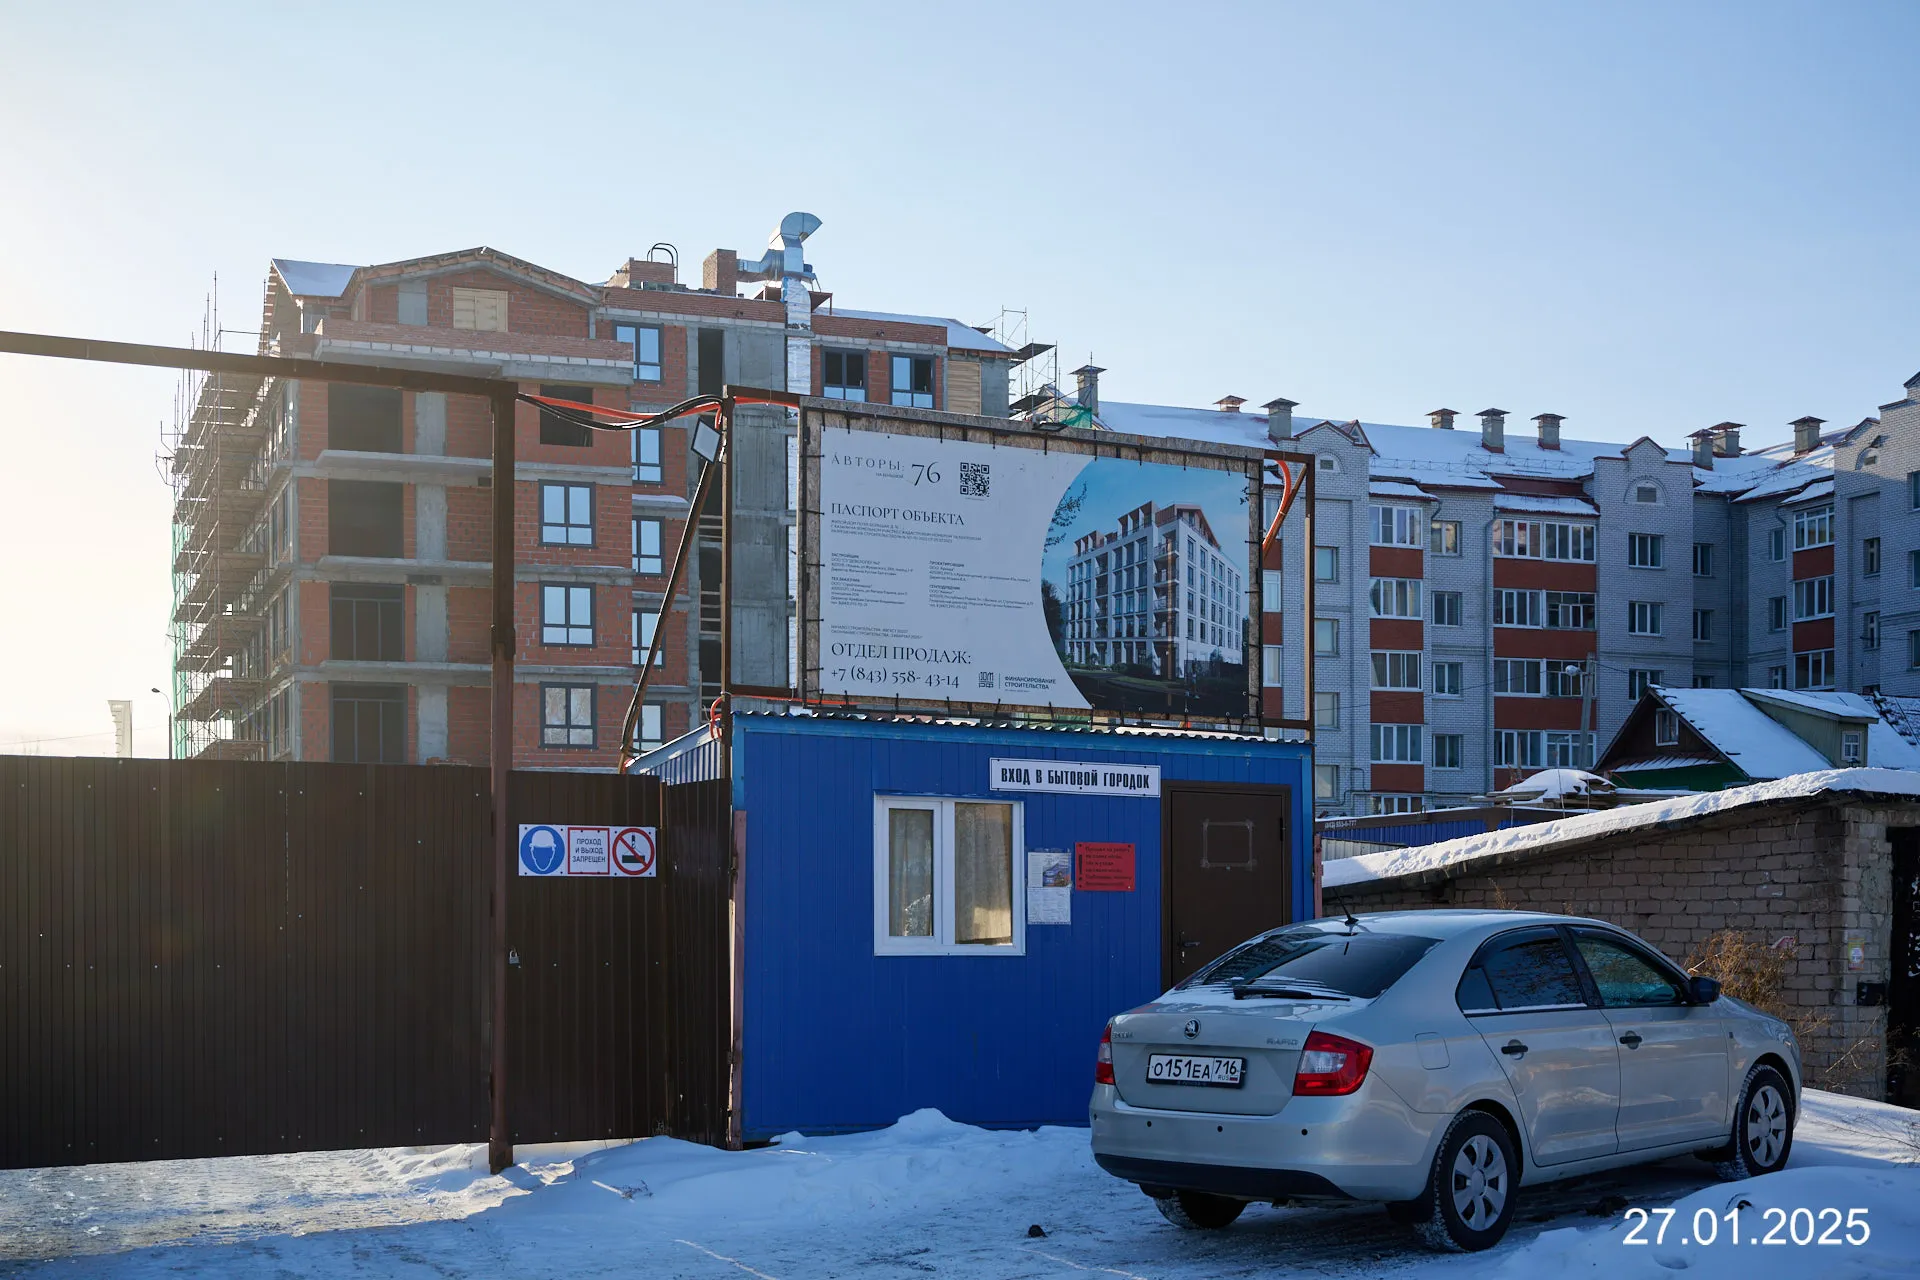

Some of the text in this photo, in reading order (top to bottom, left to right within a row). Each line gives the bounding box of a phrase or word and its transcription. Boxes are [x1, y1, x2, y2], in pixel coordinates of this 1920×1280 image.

[911, 461, 941, 486] 76
[831, 502, 965, 526] ПАСПОРТ ОБЪЕКТА
[831, 642, 971, 665] ОТДЕЛ ПРОДАЖ:
[831, 665, 960, 688] +7 (843) 558- 43-14
[1004, 675, 1056, 685] ФИНАНСИРОВАНИЕ
[1004, 682, 1049, 690] СТРОИТЕЛЬСТВА
[1001, 768, 1150, 790] ВХОД В БЫТОВОЙ ГОРОДОК
[1215, 1060, 1237, 1075] 716
